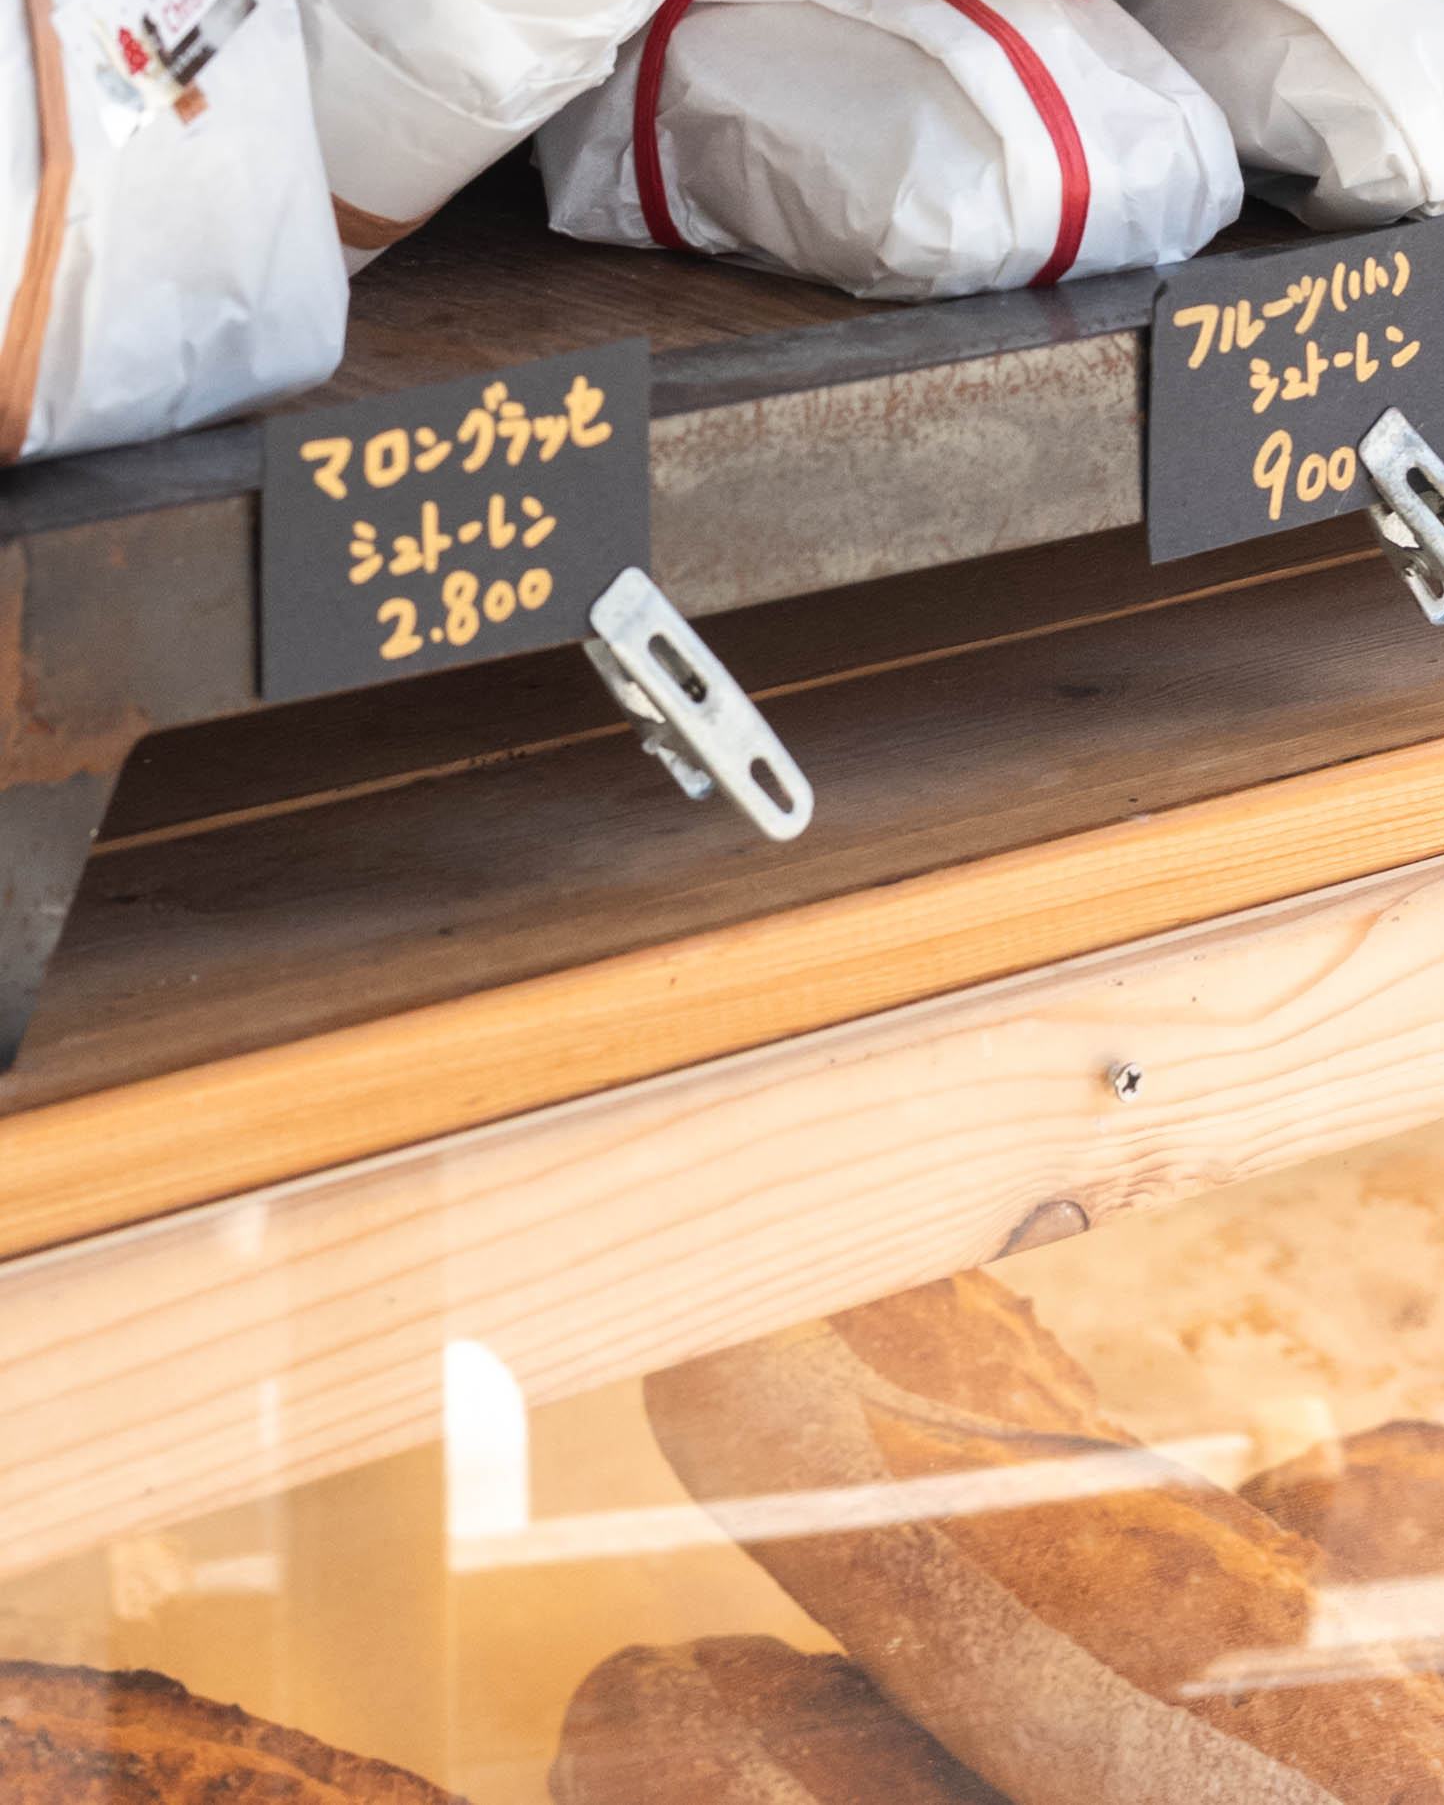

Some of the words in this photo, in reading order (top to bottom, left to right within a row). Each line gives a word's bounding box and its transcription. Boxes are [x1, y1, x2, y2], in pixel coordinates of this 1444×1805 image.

[1250, 325, 1421, 414] シュトーレン
[300, 375, 613, 500] マロングラッセ
[1252, 429, 1357, 520] 900
[349, 494, 557, 585] シュトーレン
[377, 568, 553, 660] 2.800
